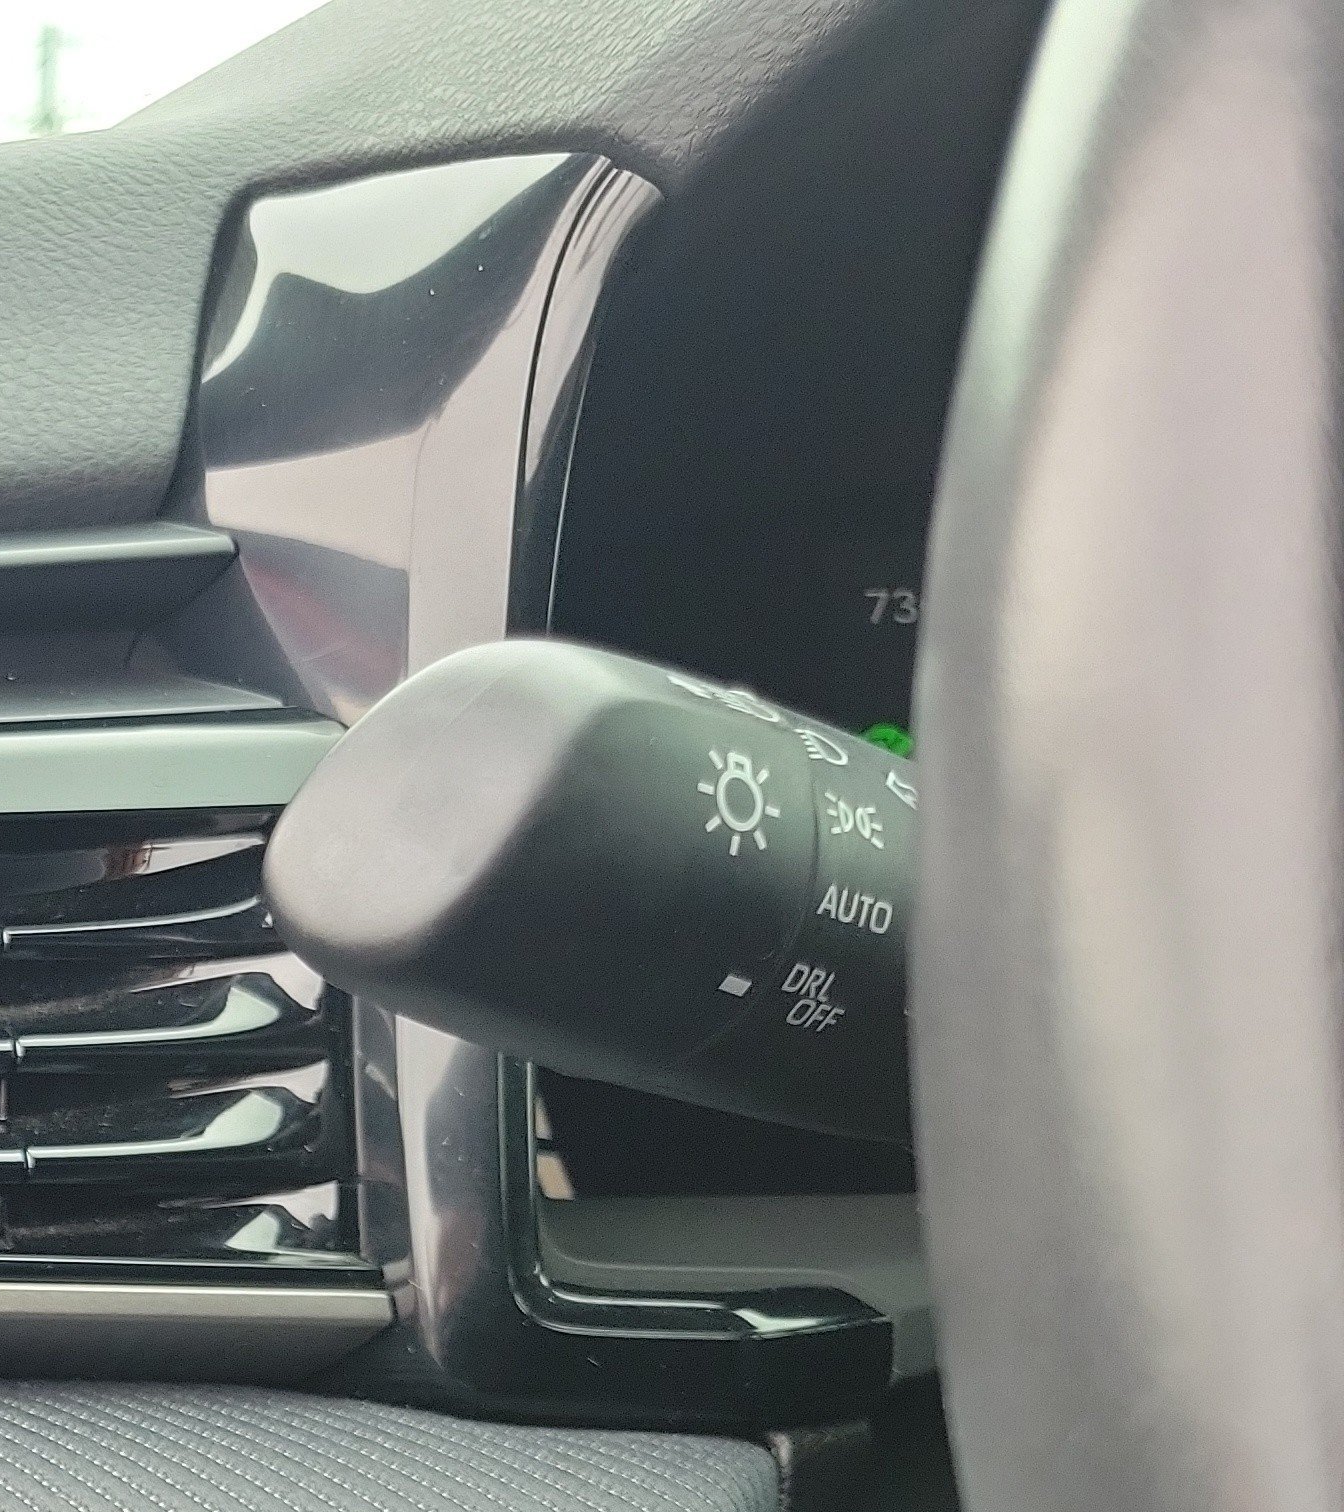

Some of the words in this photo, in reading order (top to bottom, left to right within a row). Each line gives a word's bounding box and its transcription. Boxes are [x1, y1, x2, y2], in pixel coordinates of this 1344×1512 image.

[817, 884, 893, 935] AUTO
[781, 962, 836, 1003] DRL
[785, 999, 845, 1032] OFF
